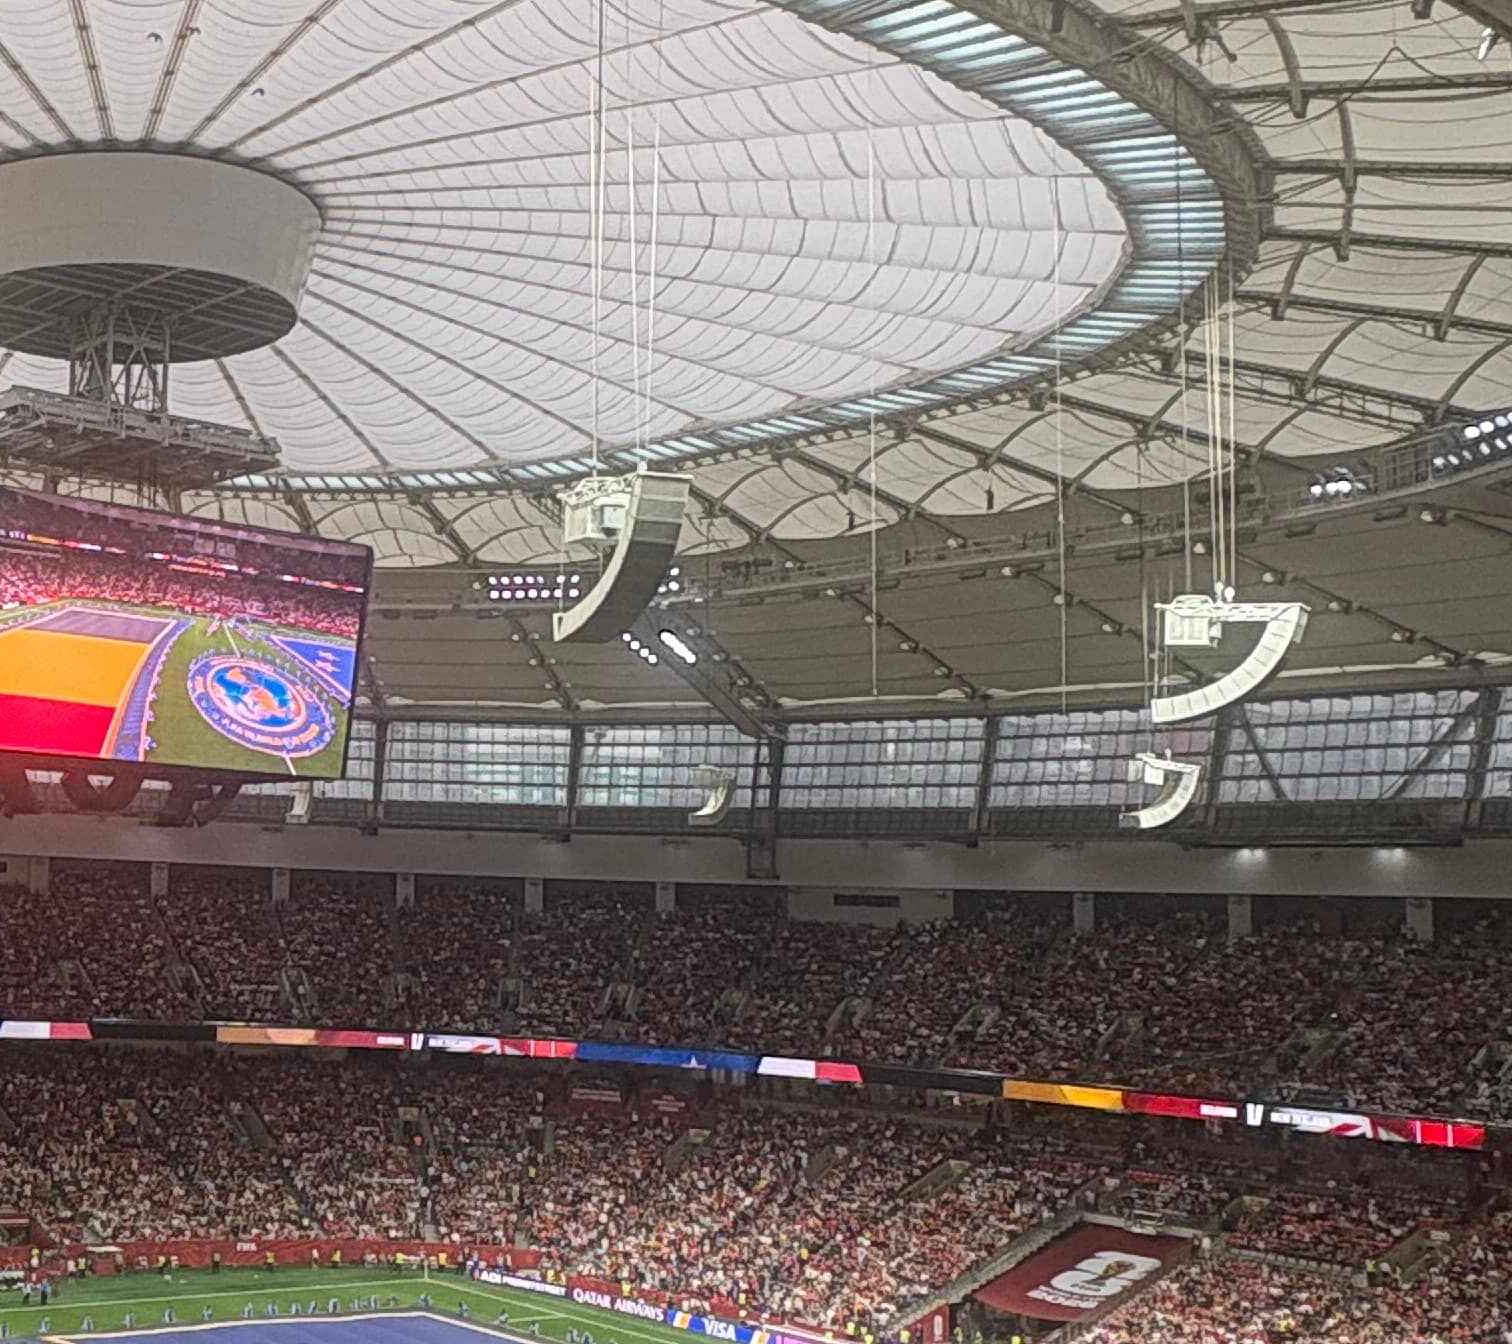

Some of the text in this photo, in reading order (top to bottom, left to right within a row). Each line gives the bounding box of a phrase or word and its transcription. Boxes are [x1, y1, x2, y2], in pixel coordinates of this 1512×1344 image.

[573, 1287, 664, 1322] QATAR AIRWAYS
[701, 1317, 737, 1342] VISA
